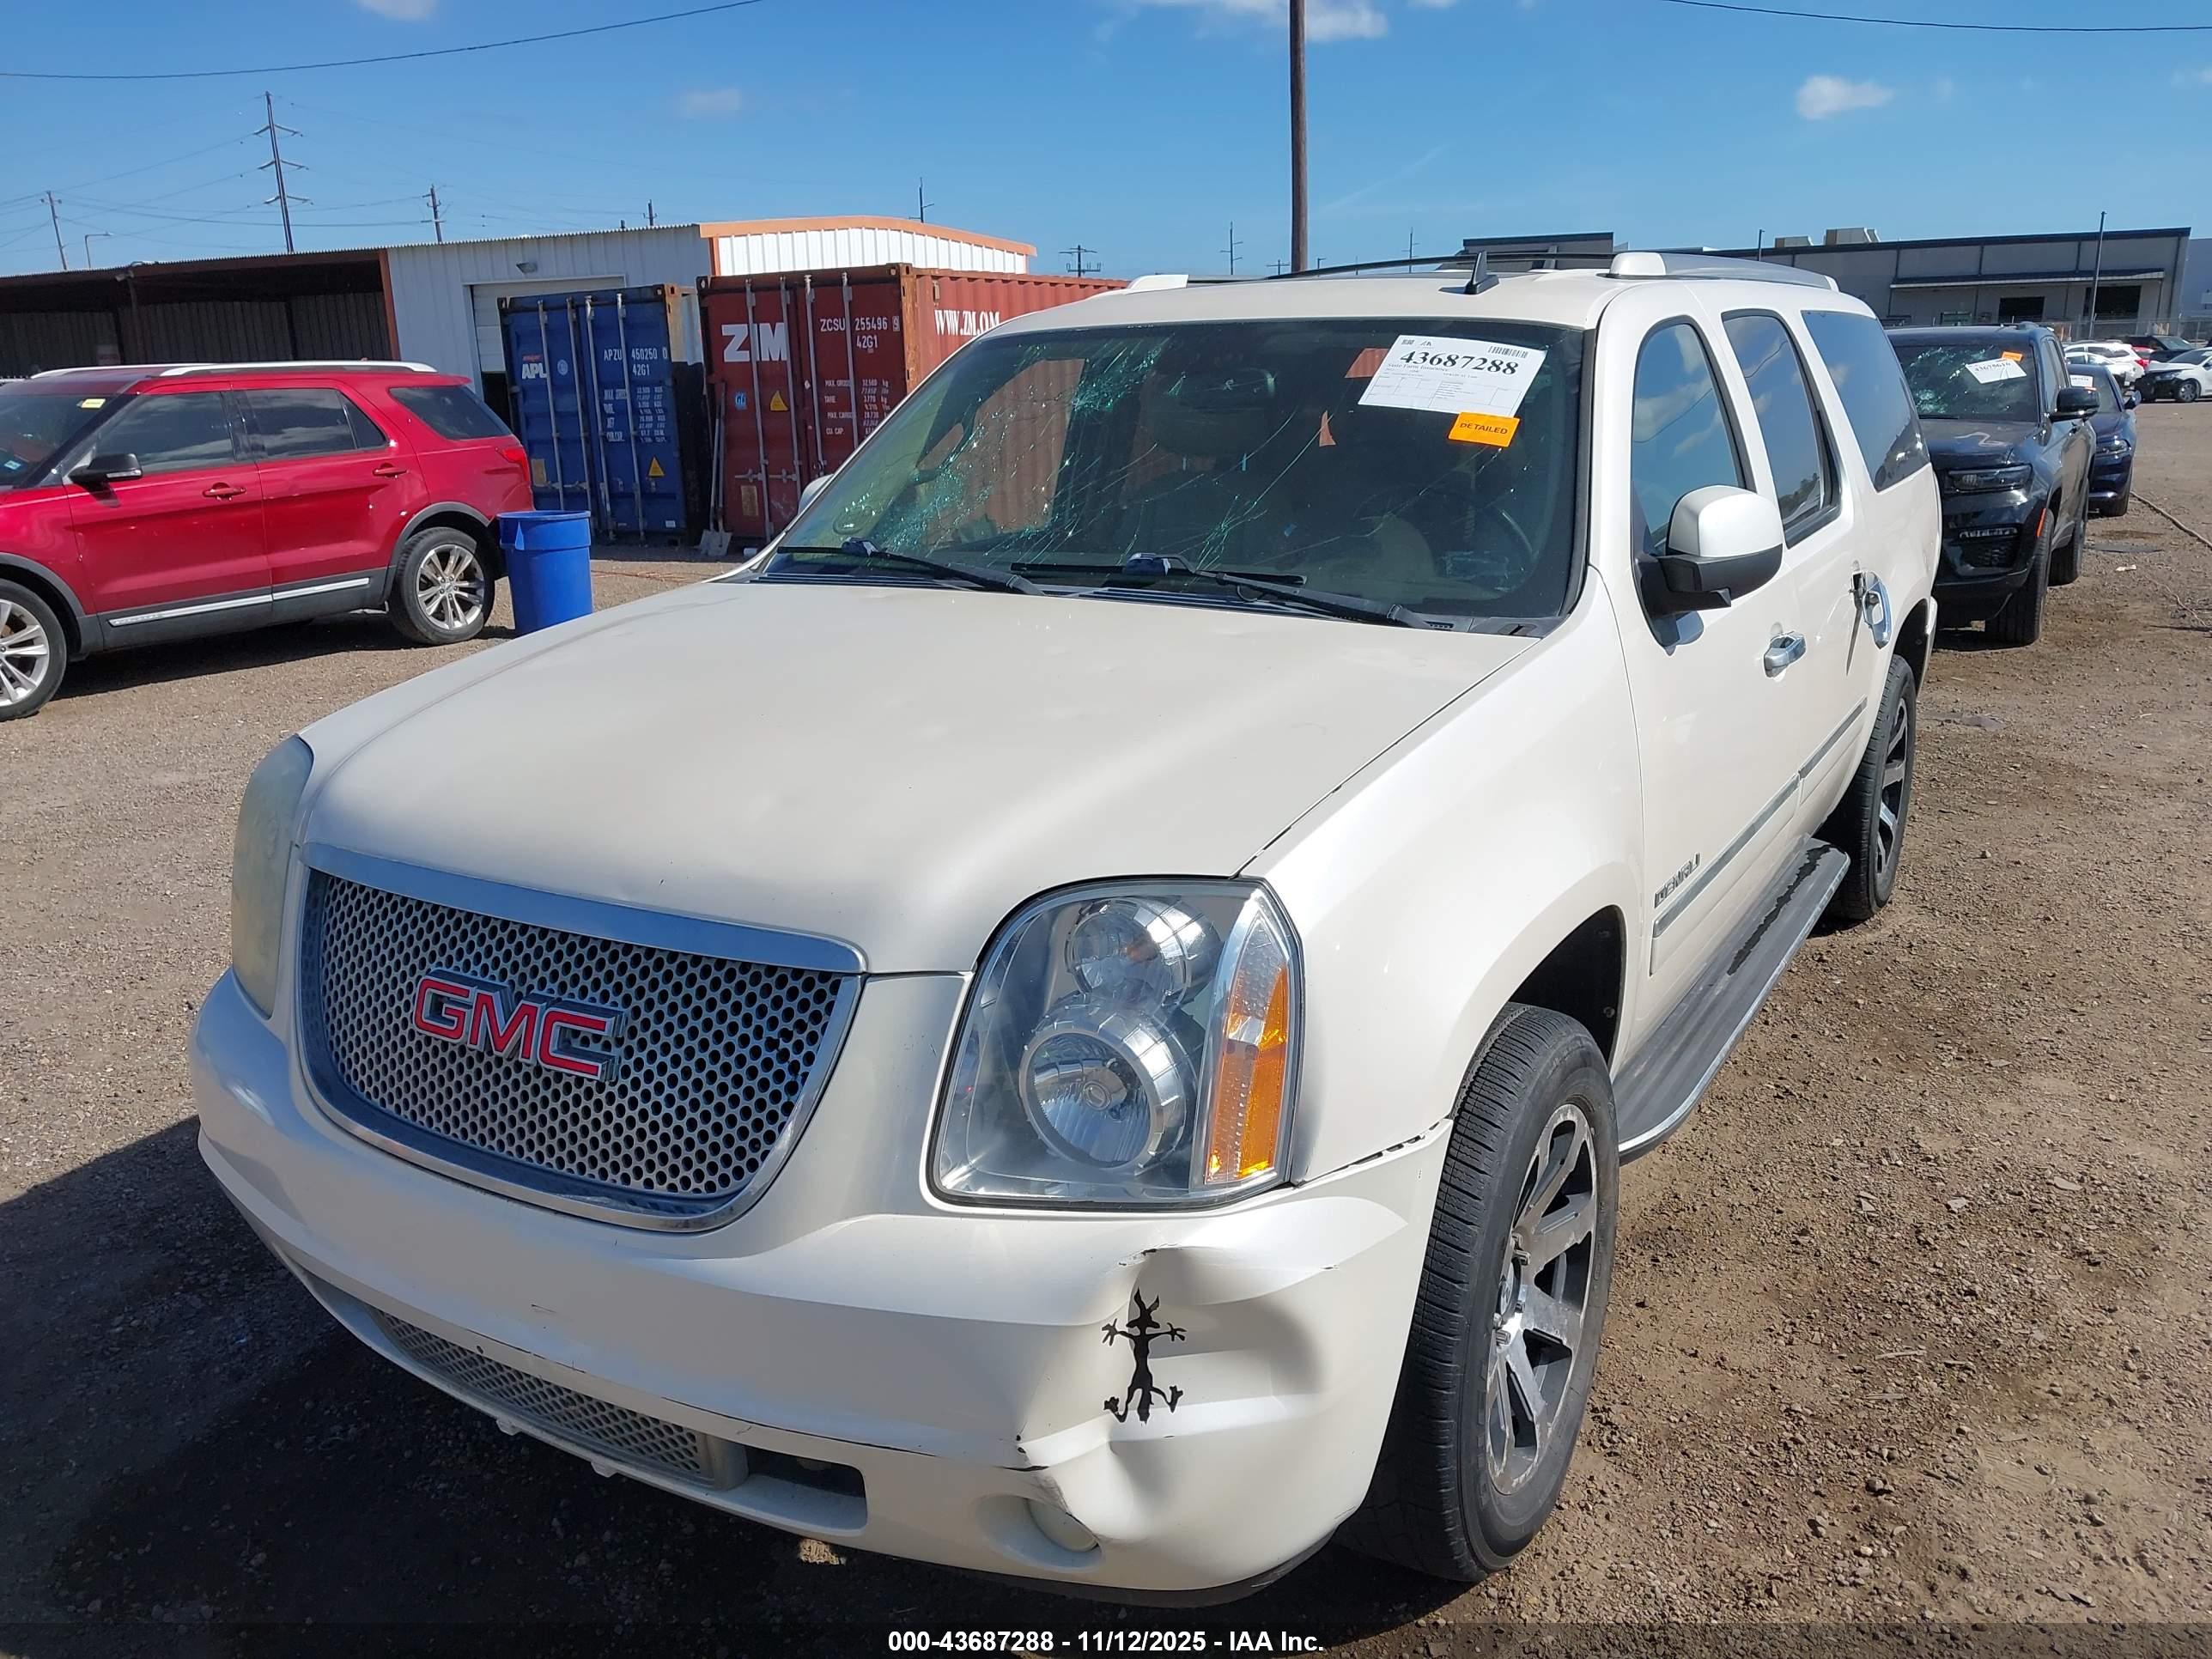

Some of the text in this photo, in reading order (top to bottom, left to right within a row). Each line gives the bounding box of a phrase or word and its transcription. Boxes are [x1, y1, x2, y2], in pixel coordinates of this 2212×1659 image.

[820, 316, 900, 332] ZCSU 255496 9
[721, 322, 787, 362] ZIM
[856, 334, 878, 349] 42G1
[604, 349, 623, 362] APZU
[631, 347, 658, 361] 450250
[1400, 350, 1519, 375] 43687288
[521, 362, 548, 380] APL
[632, 363, 650, 376] 42G1
[1460, 422, 1508, 434] DETAILED
[414, 970, 622, 1081] GMC
